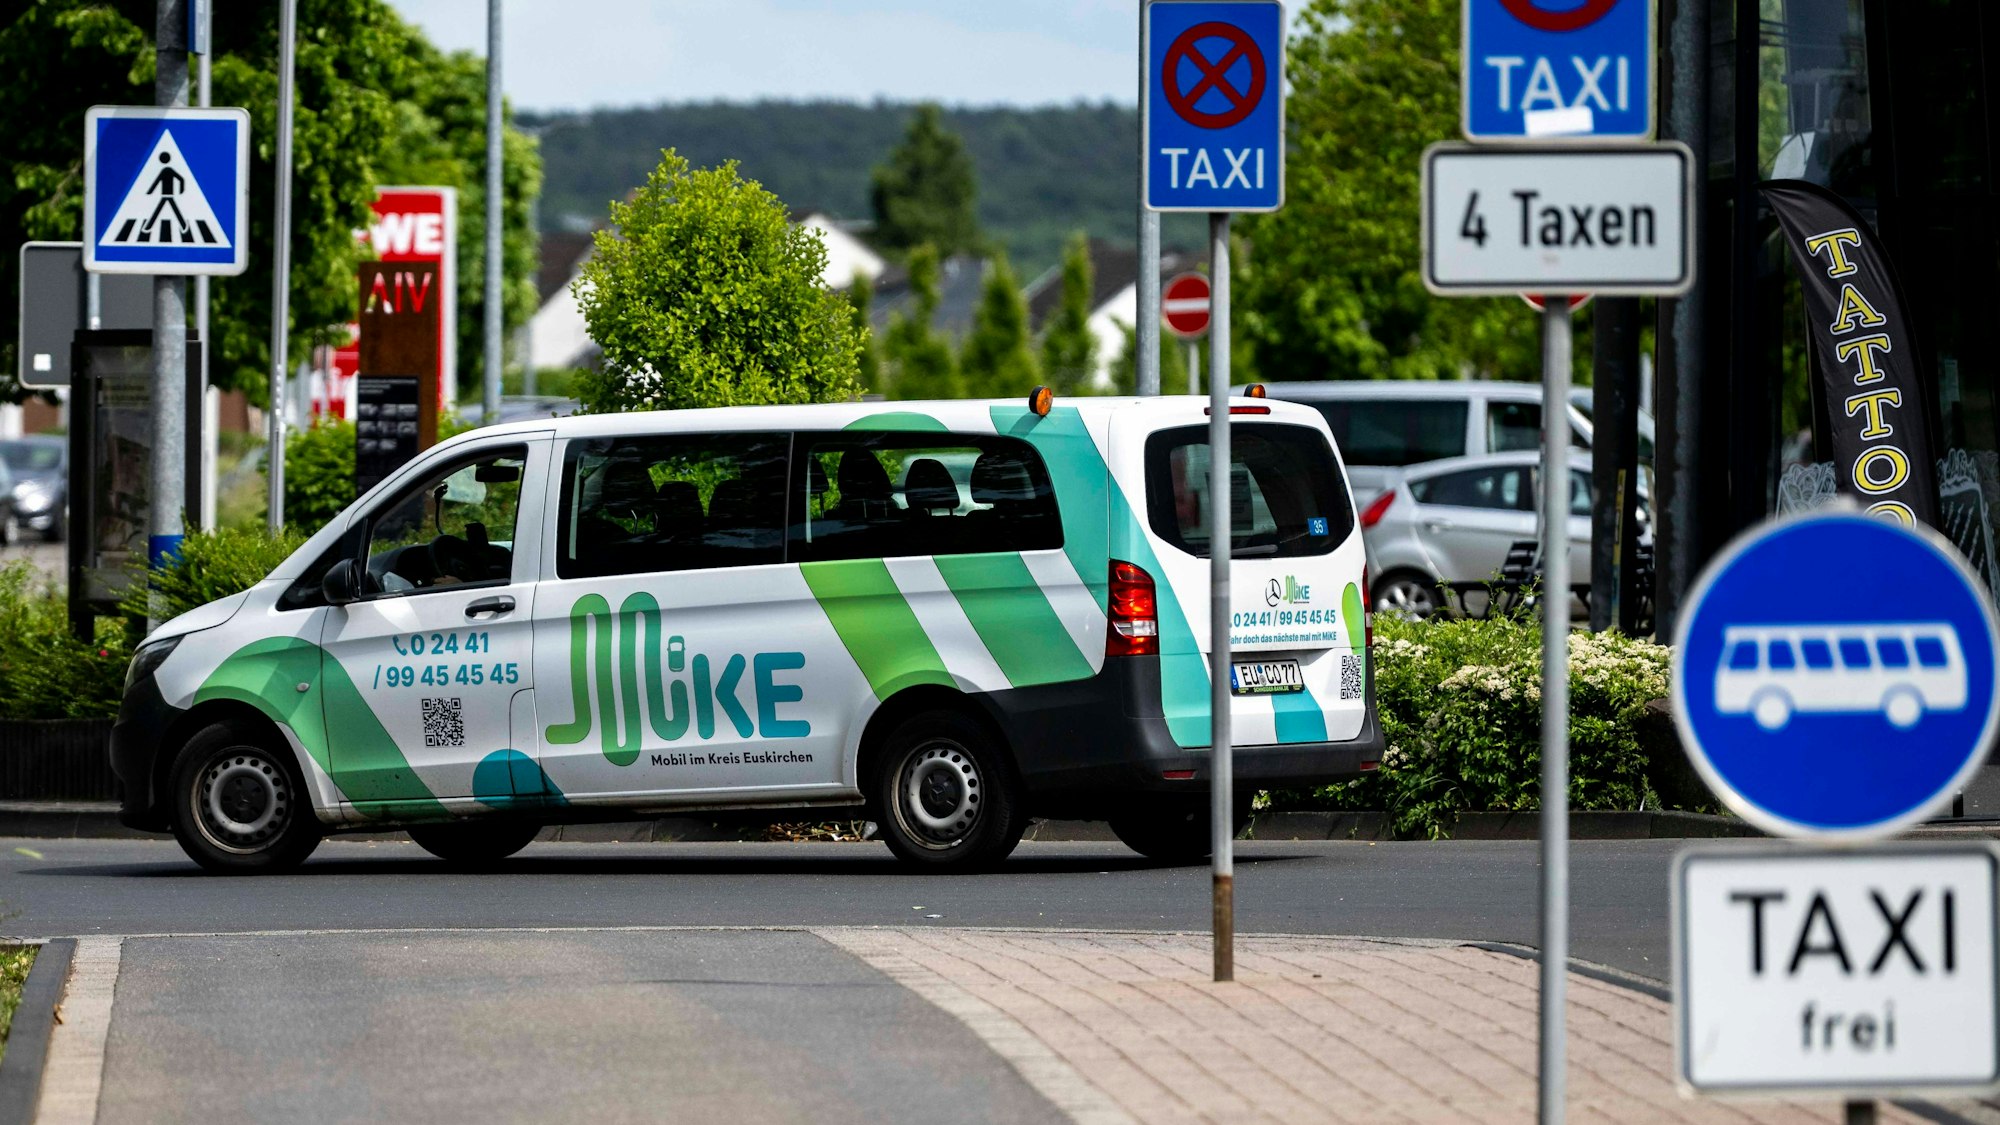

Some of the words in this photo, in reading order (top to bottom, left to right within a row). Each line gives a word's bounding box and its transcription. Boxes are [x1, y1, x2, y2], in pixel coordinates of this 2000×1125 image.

[1485, 56, 1629, 112] TAXI
[1161, 148, 1265, 189] TAXI
[1461, 189, 1488, 247] 4
[1511, 189, 1656, 247] Taxen
[1313, 519, 1324, 534] 35
[1233, 613, 1241, 628] 0
[1243, 612, 1257, 627] 24
[1260, 611, 1271, 627] 41
[1280, 611, 1293, 625] 99
[1294, 610, 1307, 625] 45
[1309, 610, 1322, 625] 45
[1323, 609, 1336, 624] 45
[411, 634, 425, 656] 0
[431, 632, 459, 655] 24
[464, 632, 489, 654] 41
[1229, 635, 1242, 645] ahr
[1243, 634, 1260, 644] doch
[1261, 634, 1273, 643] das
[1273, 633, 1299, 642] nächste
[1300, 632, 1310, 642] mal
[1312, 632, 1321, 641] mit
[386, 665, 415, 688] 99
[420, 664, 449, 687] 45
[455, 663, 484, 685] 45
[490, 662, 519, 684] 45
[1241, 665, 1260, 685] EU
[651, 753, 687, 766] Mobil
[690, 753, 705, 765] im
[708, 752, 740, 765] Kreis
[743, 750, 813, 764] Euskirchen
[1729, 889, 1957, 976] TAXI
[1799, 997, 1897, 1051] frei
